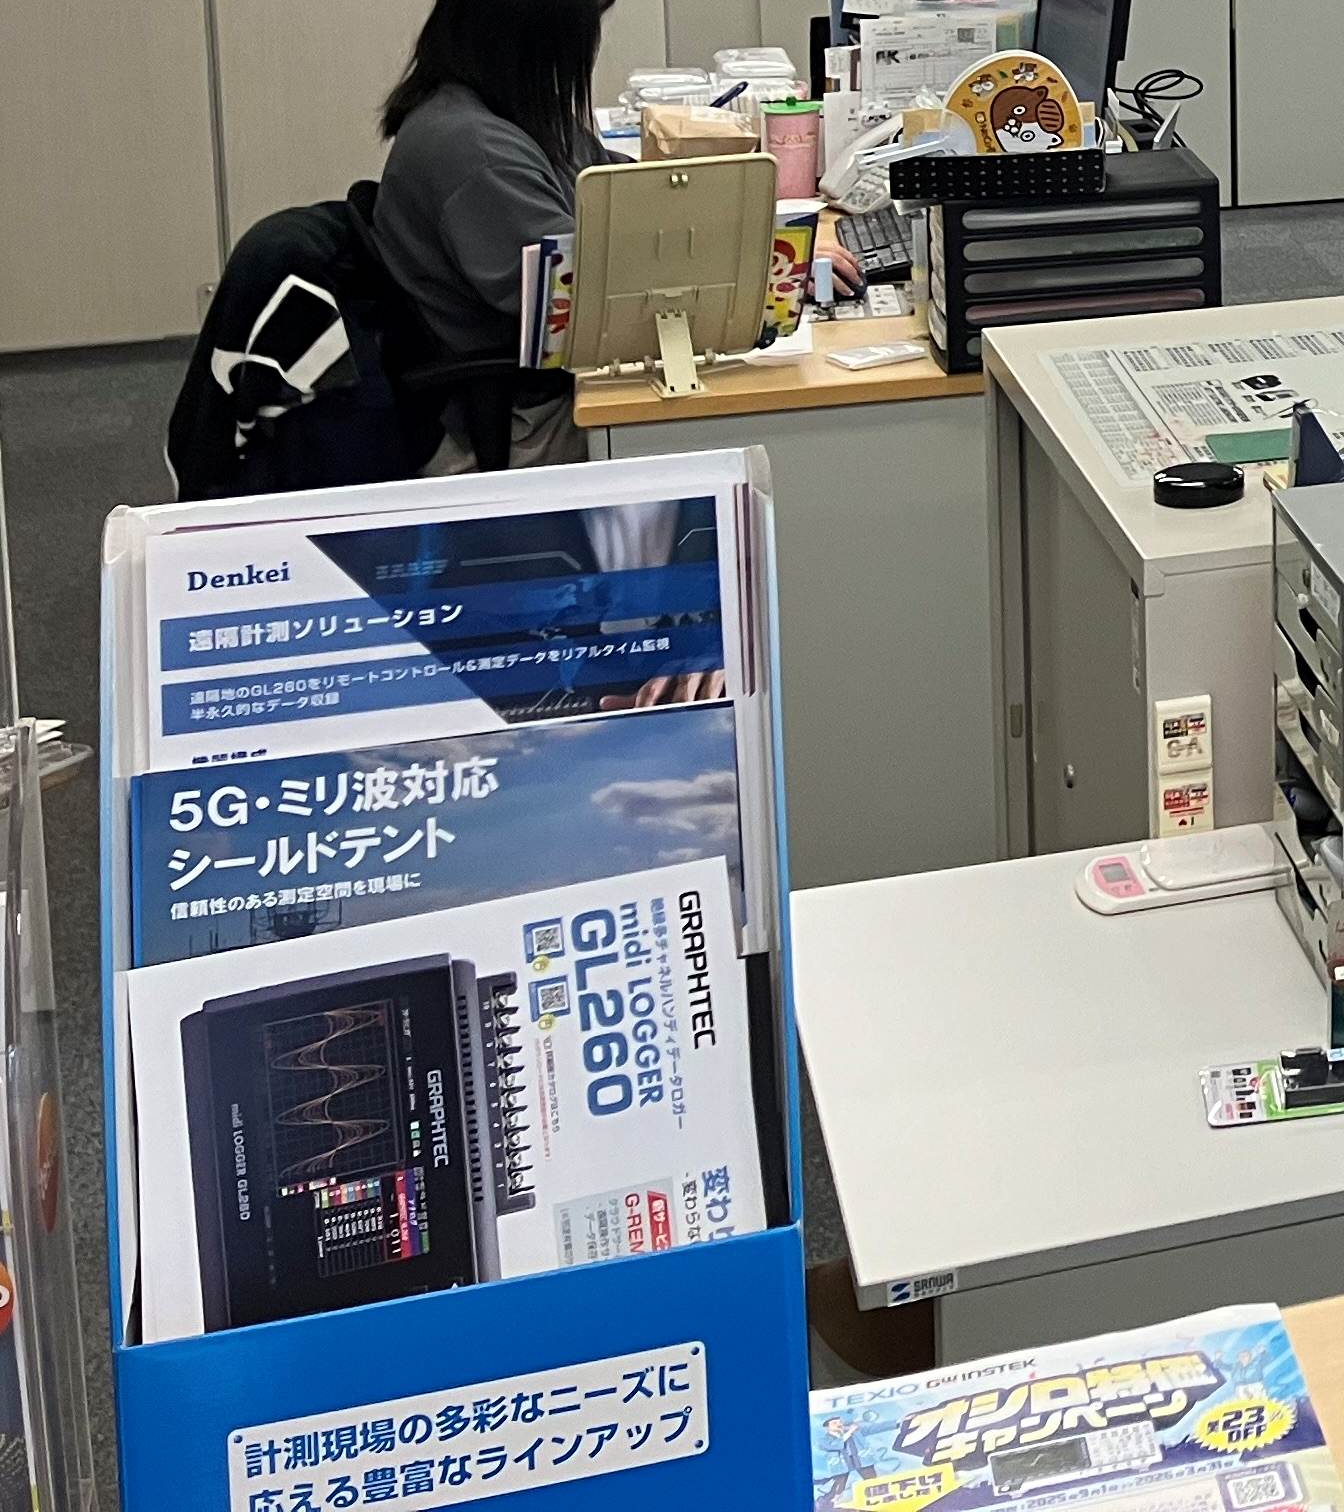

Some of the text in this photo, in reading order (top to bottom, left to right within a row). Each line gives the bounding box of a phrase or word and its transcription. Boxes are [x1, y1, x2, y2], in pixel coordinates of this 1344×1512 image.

[187, 562, 291, 591] Denkei
[188, 604, 463, 653] 遠隔計測ソリューション
[169, 756, 500, 833] 5G・ミリ波対応
[167, 817, 455, 891] シールドテント
[170, 872, 421, 920] 信頼性のある測定空間を現場に
[620, 901, 665, 1108] midi LOGGER
[679, 890, 717, 1050] GRAPHTEC
[570, 908, 633, 1118] GL260
[233, 1130, 247, 1176] LOGGER
[427, 1069, 448, 1168] GRAPHTEC
[914, 1273, 954, 1292] SANWA
[245, 1362, 691, 1479] 計測現場の多彩なニーズに
[826, 1383, 919, 1409] TEXIO
[960, 1358, 1037, 1383] INSTEK
[248, 1405, 693, 1512] 応える豊富なラインアップ
[929, 1390, 1188, 1464] キャンペーン
[1228, 1423, 1267, 1444] OFF
